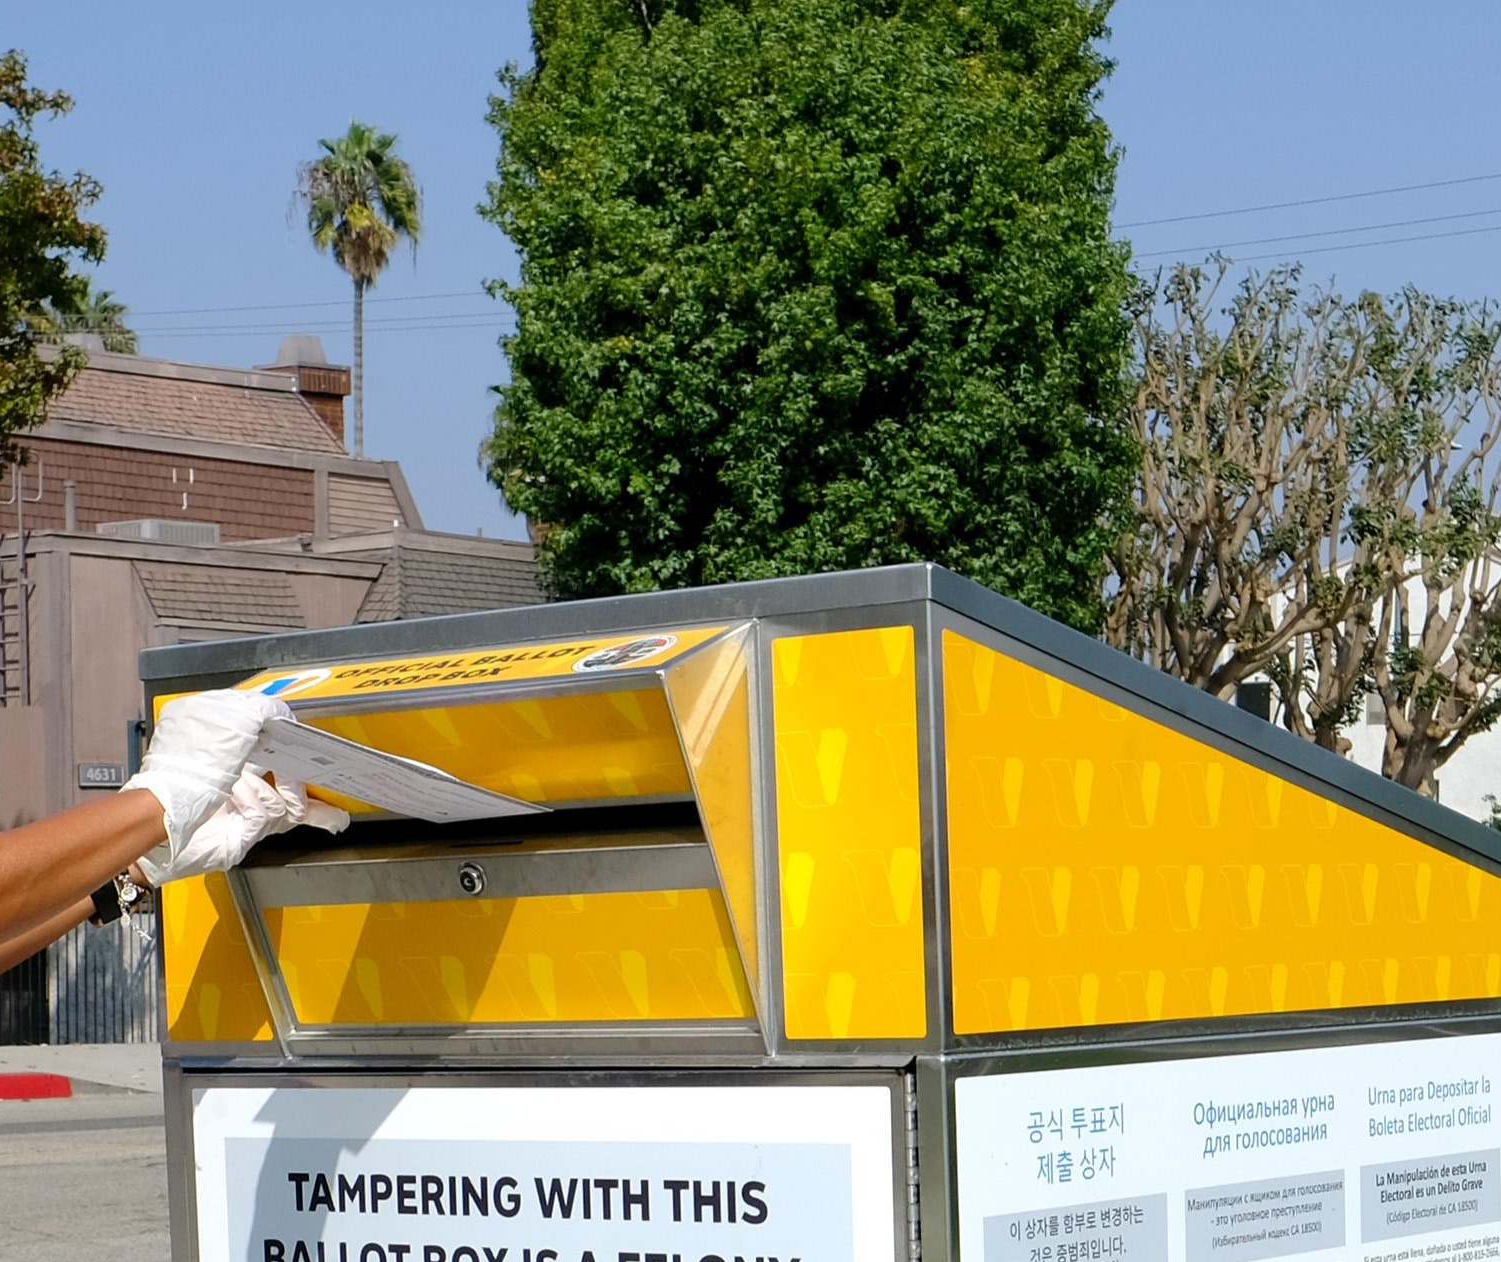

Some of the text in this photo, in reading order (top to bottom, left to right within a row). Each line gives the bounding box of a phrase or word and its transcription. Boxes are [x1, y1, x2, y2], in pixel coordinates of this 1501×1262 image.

[334, 653, 474, 679] OFFICIAL
[477, 645, 599, 664] BALLOT
[351, 666, 512, 689] DROP BOX
[86, 767, 117, 781] 4631
[1368, 1074, 1491, 1107] Urna para Depositar la
[1026, 1103, 1124, 1144] 공식 투표지
[1193, 1094, 1335, 1130] Официальная урна
[1368, 1104, 1491, 1137] Boleta Electoral Oficial
[1202, 1123, 1327, 1159] для голосования
[1036, 1145, 1117, 1185] 제출 상자
[287, 1172, 768, 1225] TAMPERING WITH THIS
